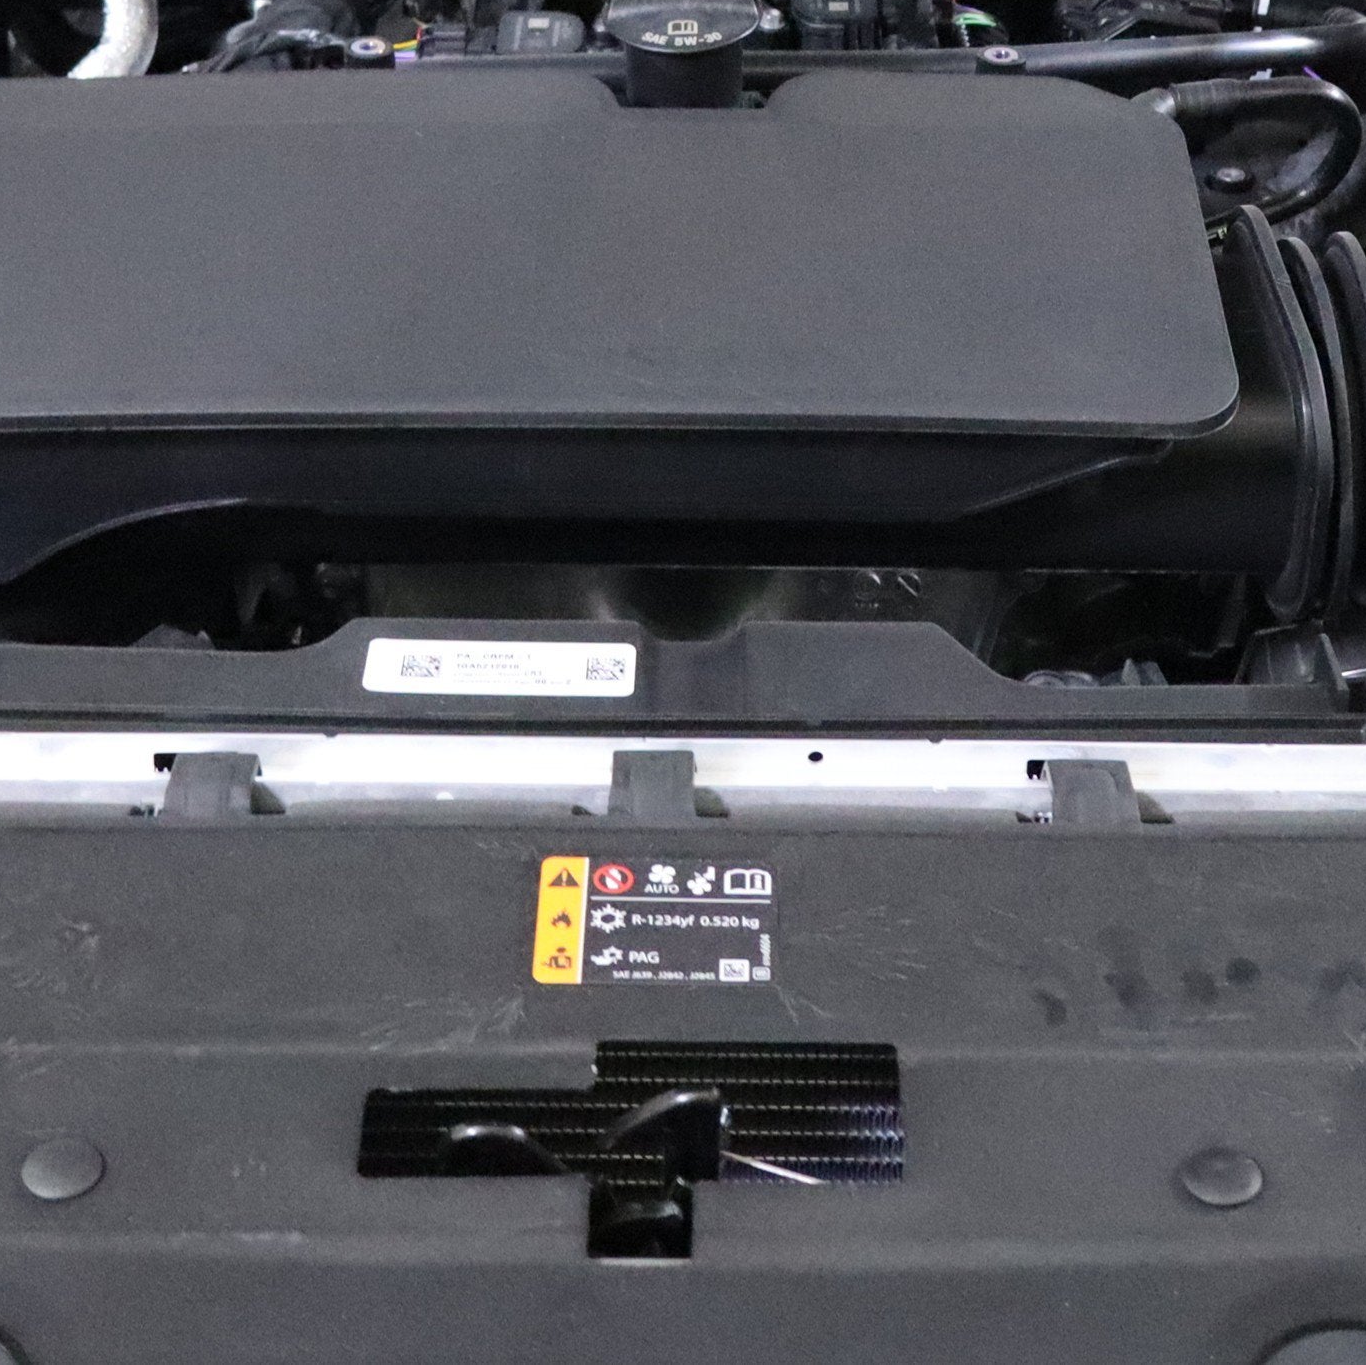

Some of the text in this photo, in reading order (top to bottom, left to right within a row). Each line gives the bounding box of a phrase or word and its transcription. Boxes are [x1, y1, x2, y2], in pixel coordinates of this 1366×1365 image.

[641, 31, 723, 47] SAE 5W-30
[644, 884, 680, 895] AUTO
[632, 914, 760, 930] R-1234yf 0.520 kg
[629, 951, 660, 964] PAG
